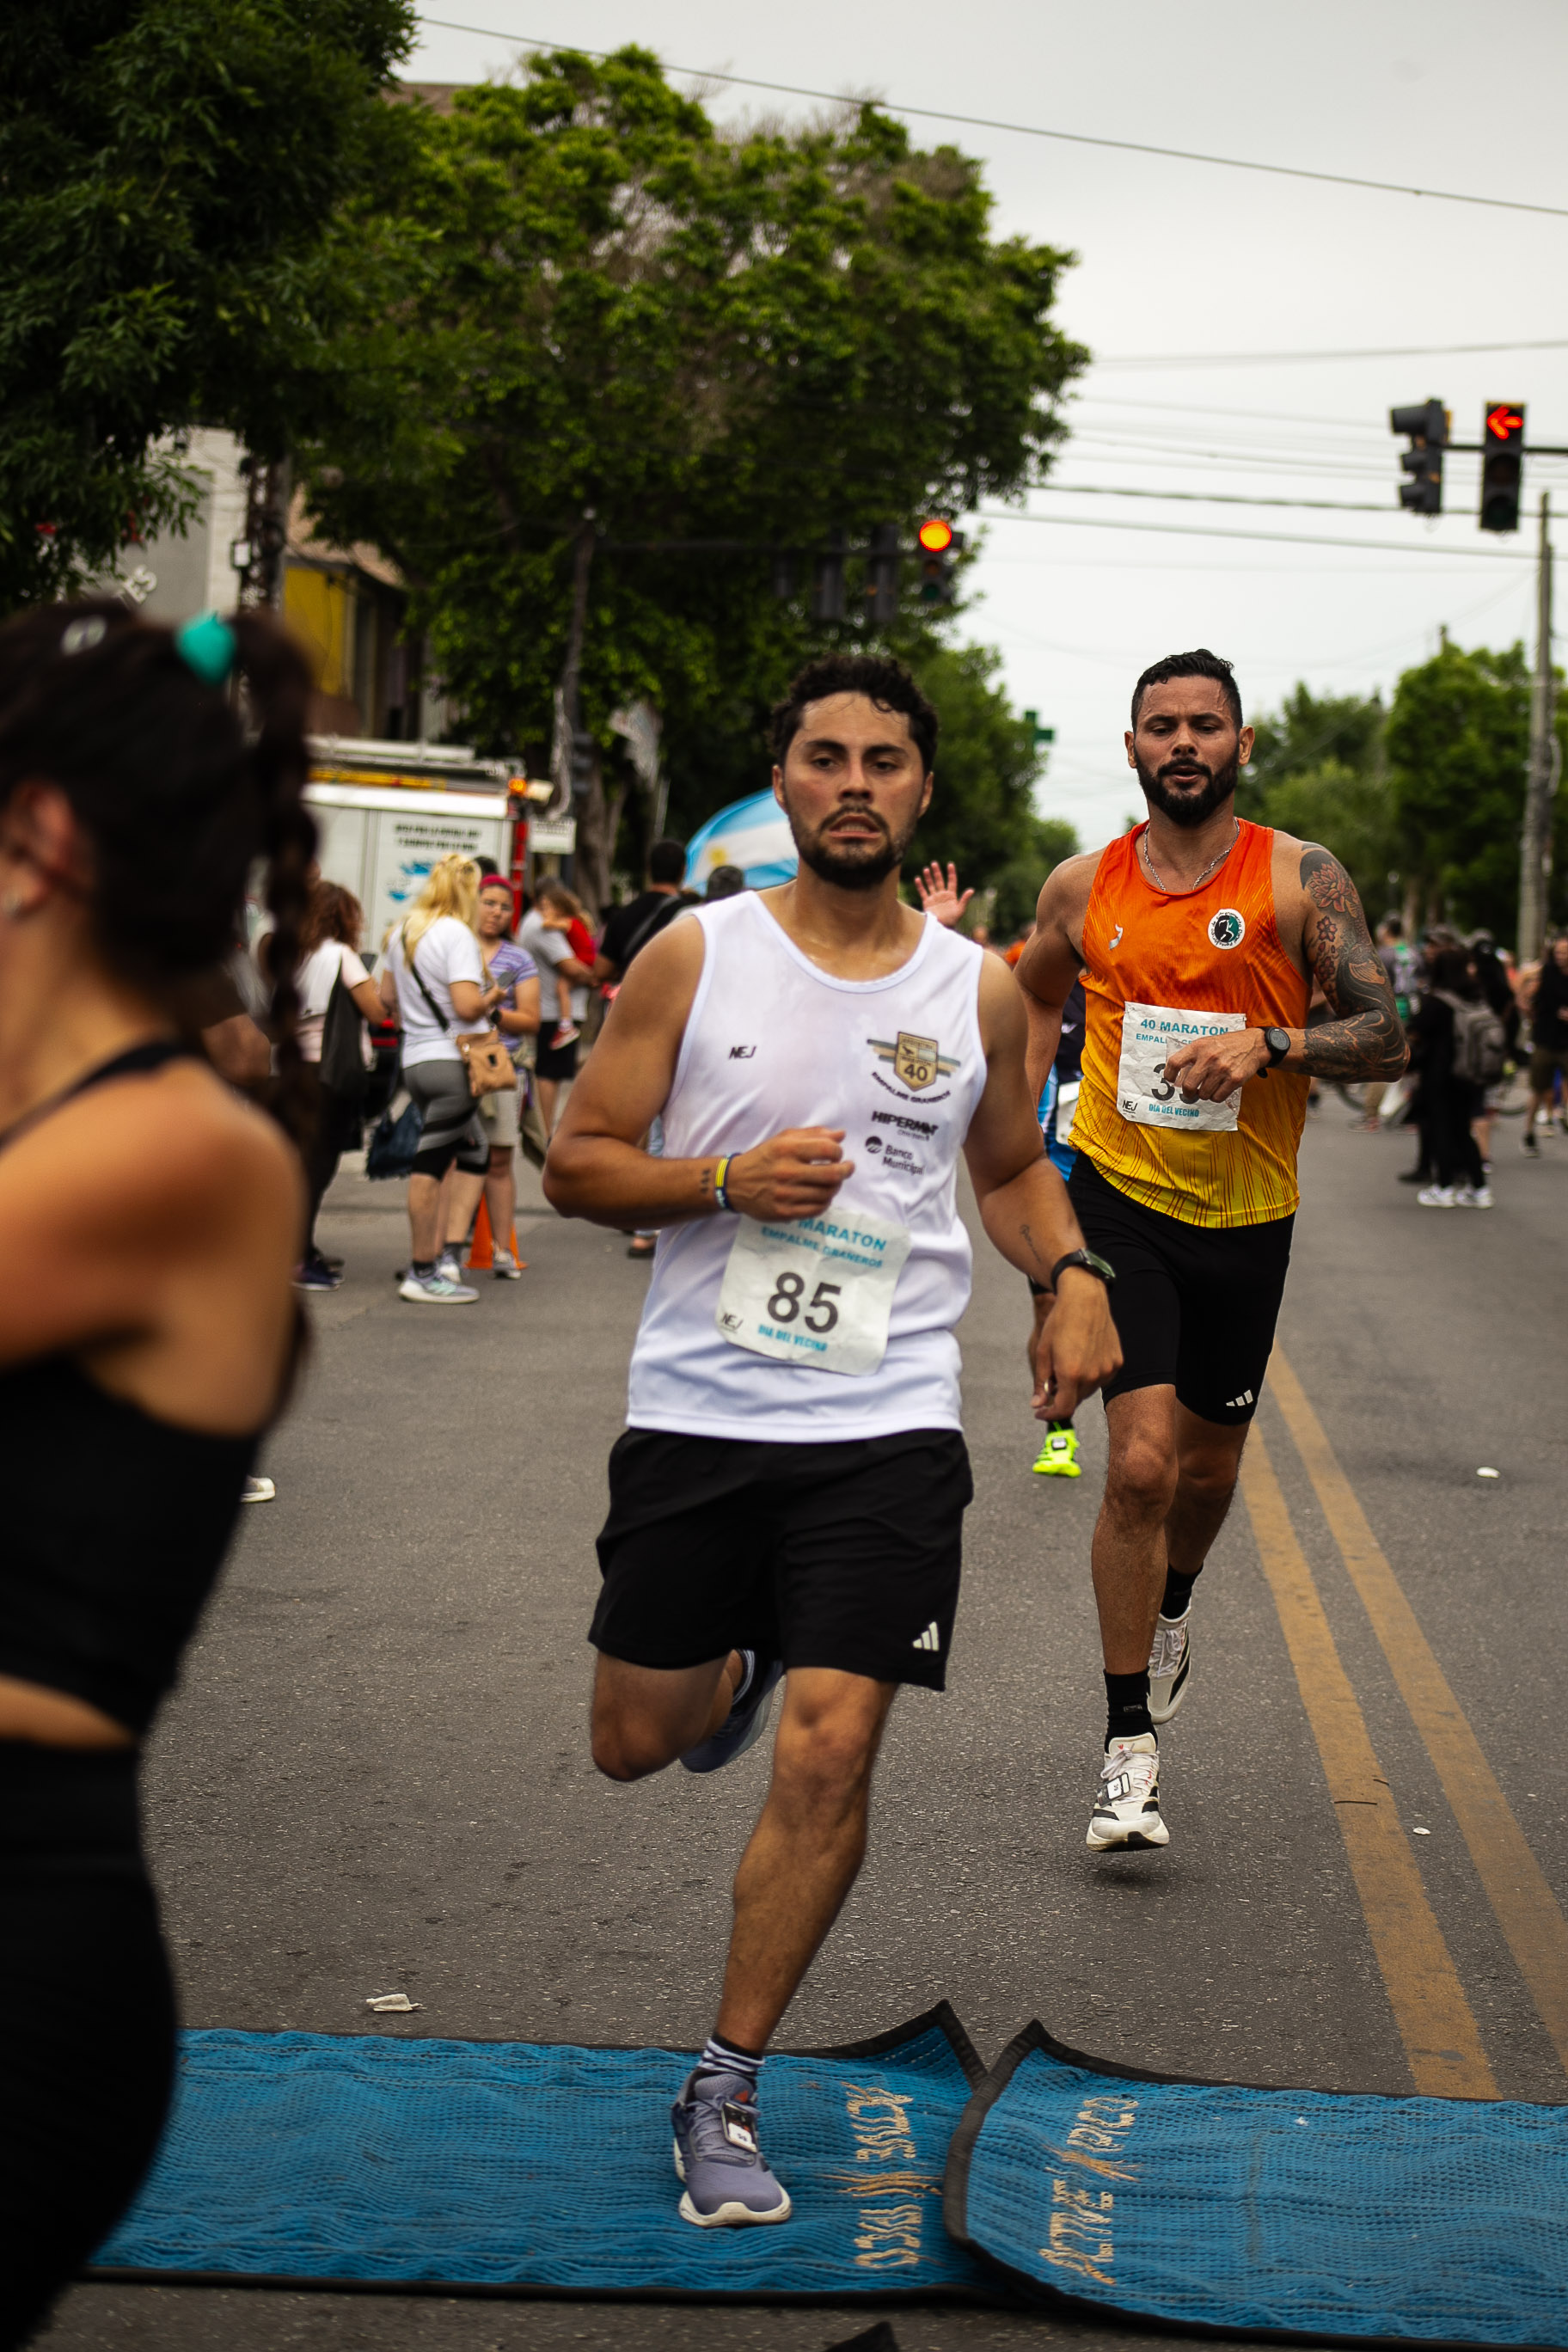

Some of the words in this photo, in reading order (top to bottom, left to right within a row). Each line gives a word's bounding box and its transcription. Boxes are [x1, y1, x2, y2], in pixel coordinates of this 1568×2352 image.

[1141, 1019, 1156, 1030] 40
[1160, 1021, 1228, 1037] MARATON
[1136, 1033, 1167, 1044] EMPAL
[729, 1046, 756, 1060] NEJ
[904, 1064, 928, 1081] 40
[1122, 1100, 1138, 1112] NEJ
[1148, 1104, 1161, 1112] DIA
[1161, 1106, 1173, 1115] DEL
[1174, 1108, 1200, 1118] VECINO
[885, 1144, 914, 1161] Banco
[883, 1156, 924, 1176] Municipal
[798, 1218, 887, 1252] MARATON
[761, 1226, 820, 1251] EMPALME
[823, 1246, 884, 1268] GRANEROS
[767, 1271, 842, 1333] 85
